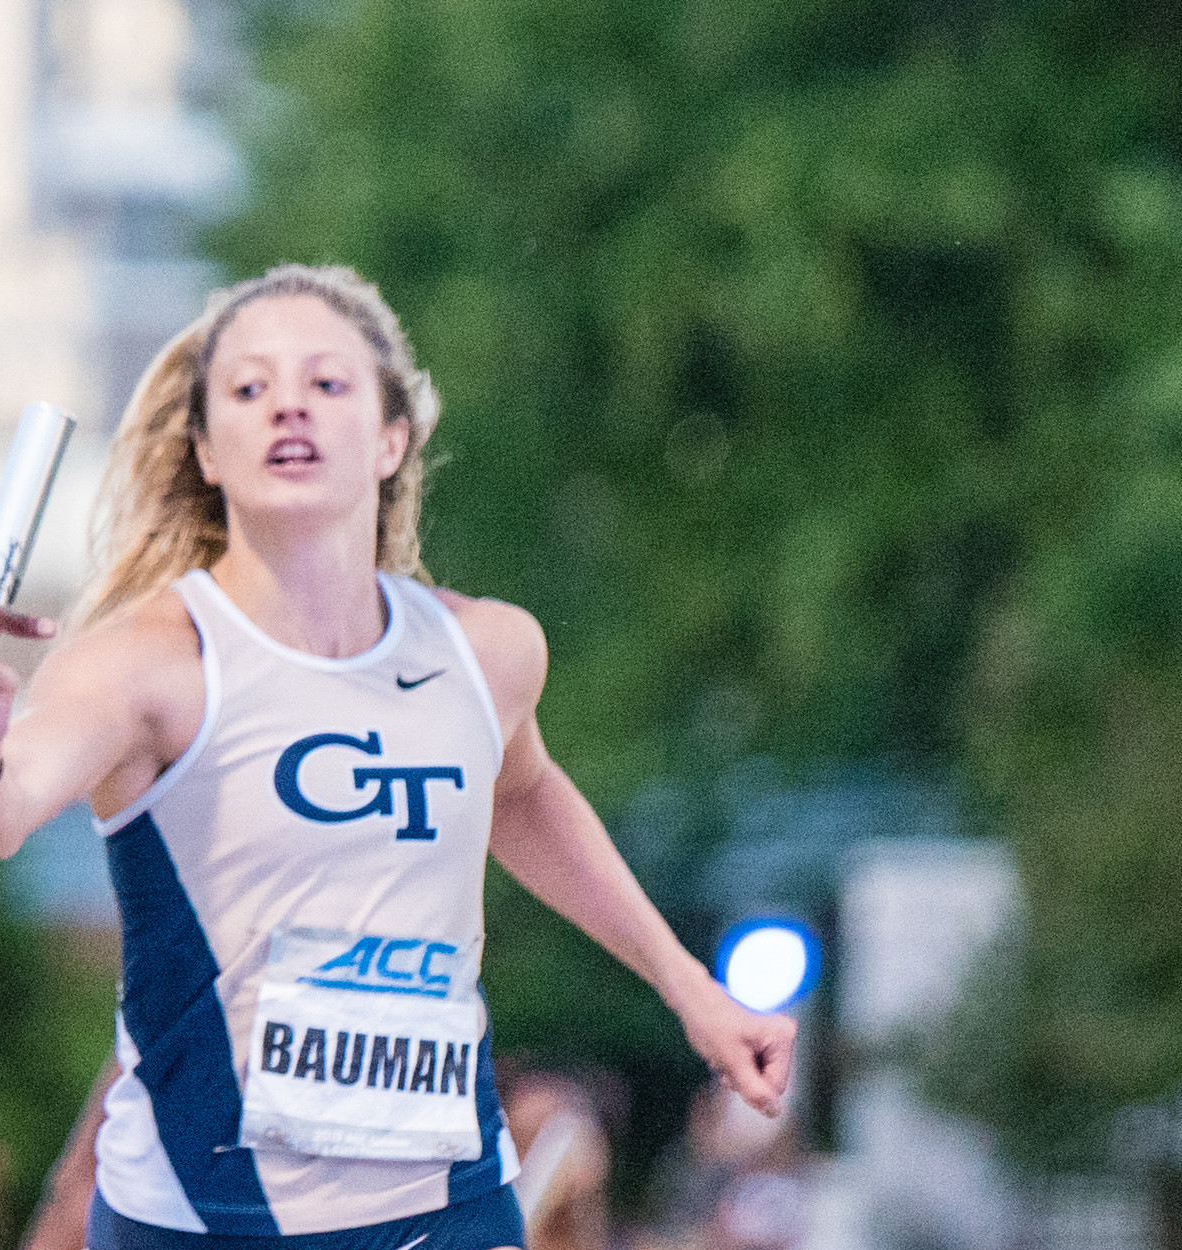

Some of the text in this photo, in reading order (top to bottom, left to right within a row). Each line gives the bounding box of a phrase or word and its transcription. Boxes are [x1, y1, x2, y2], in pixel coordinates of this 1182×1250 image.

[274, 731, 465, 840] GT
[315, 936, 458, 984] ACC
[261, 1020, 470, 1097] BAUMAN
